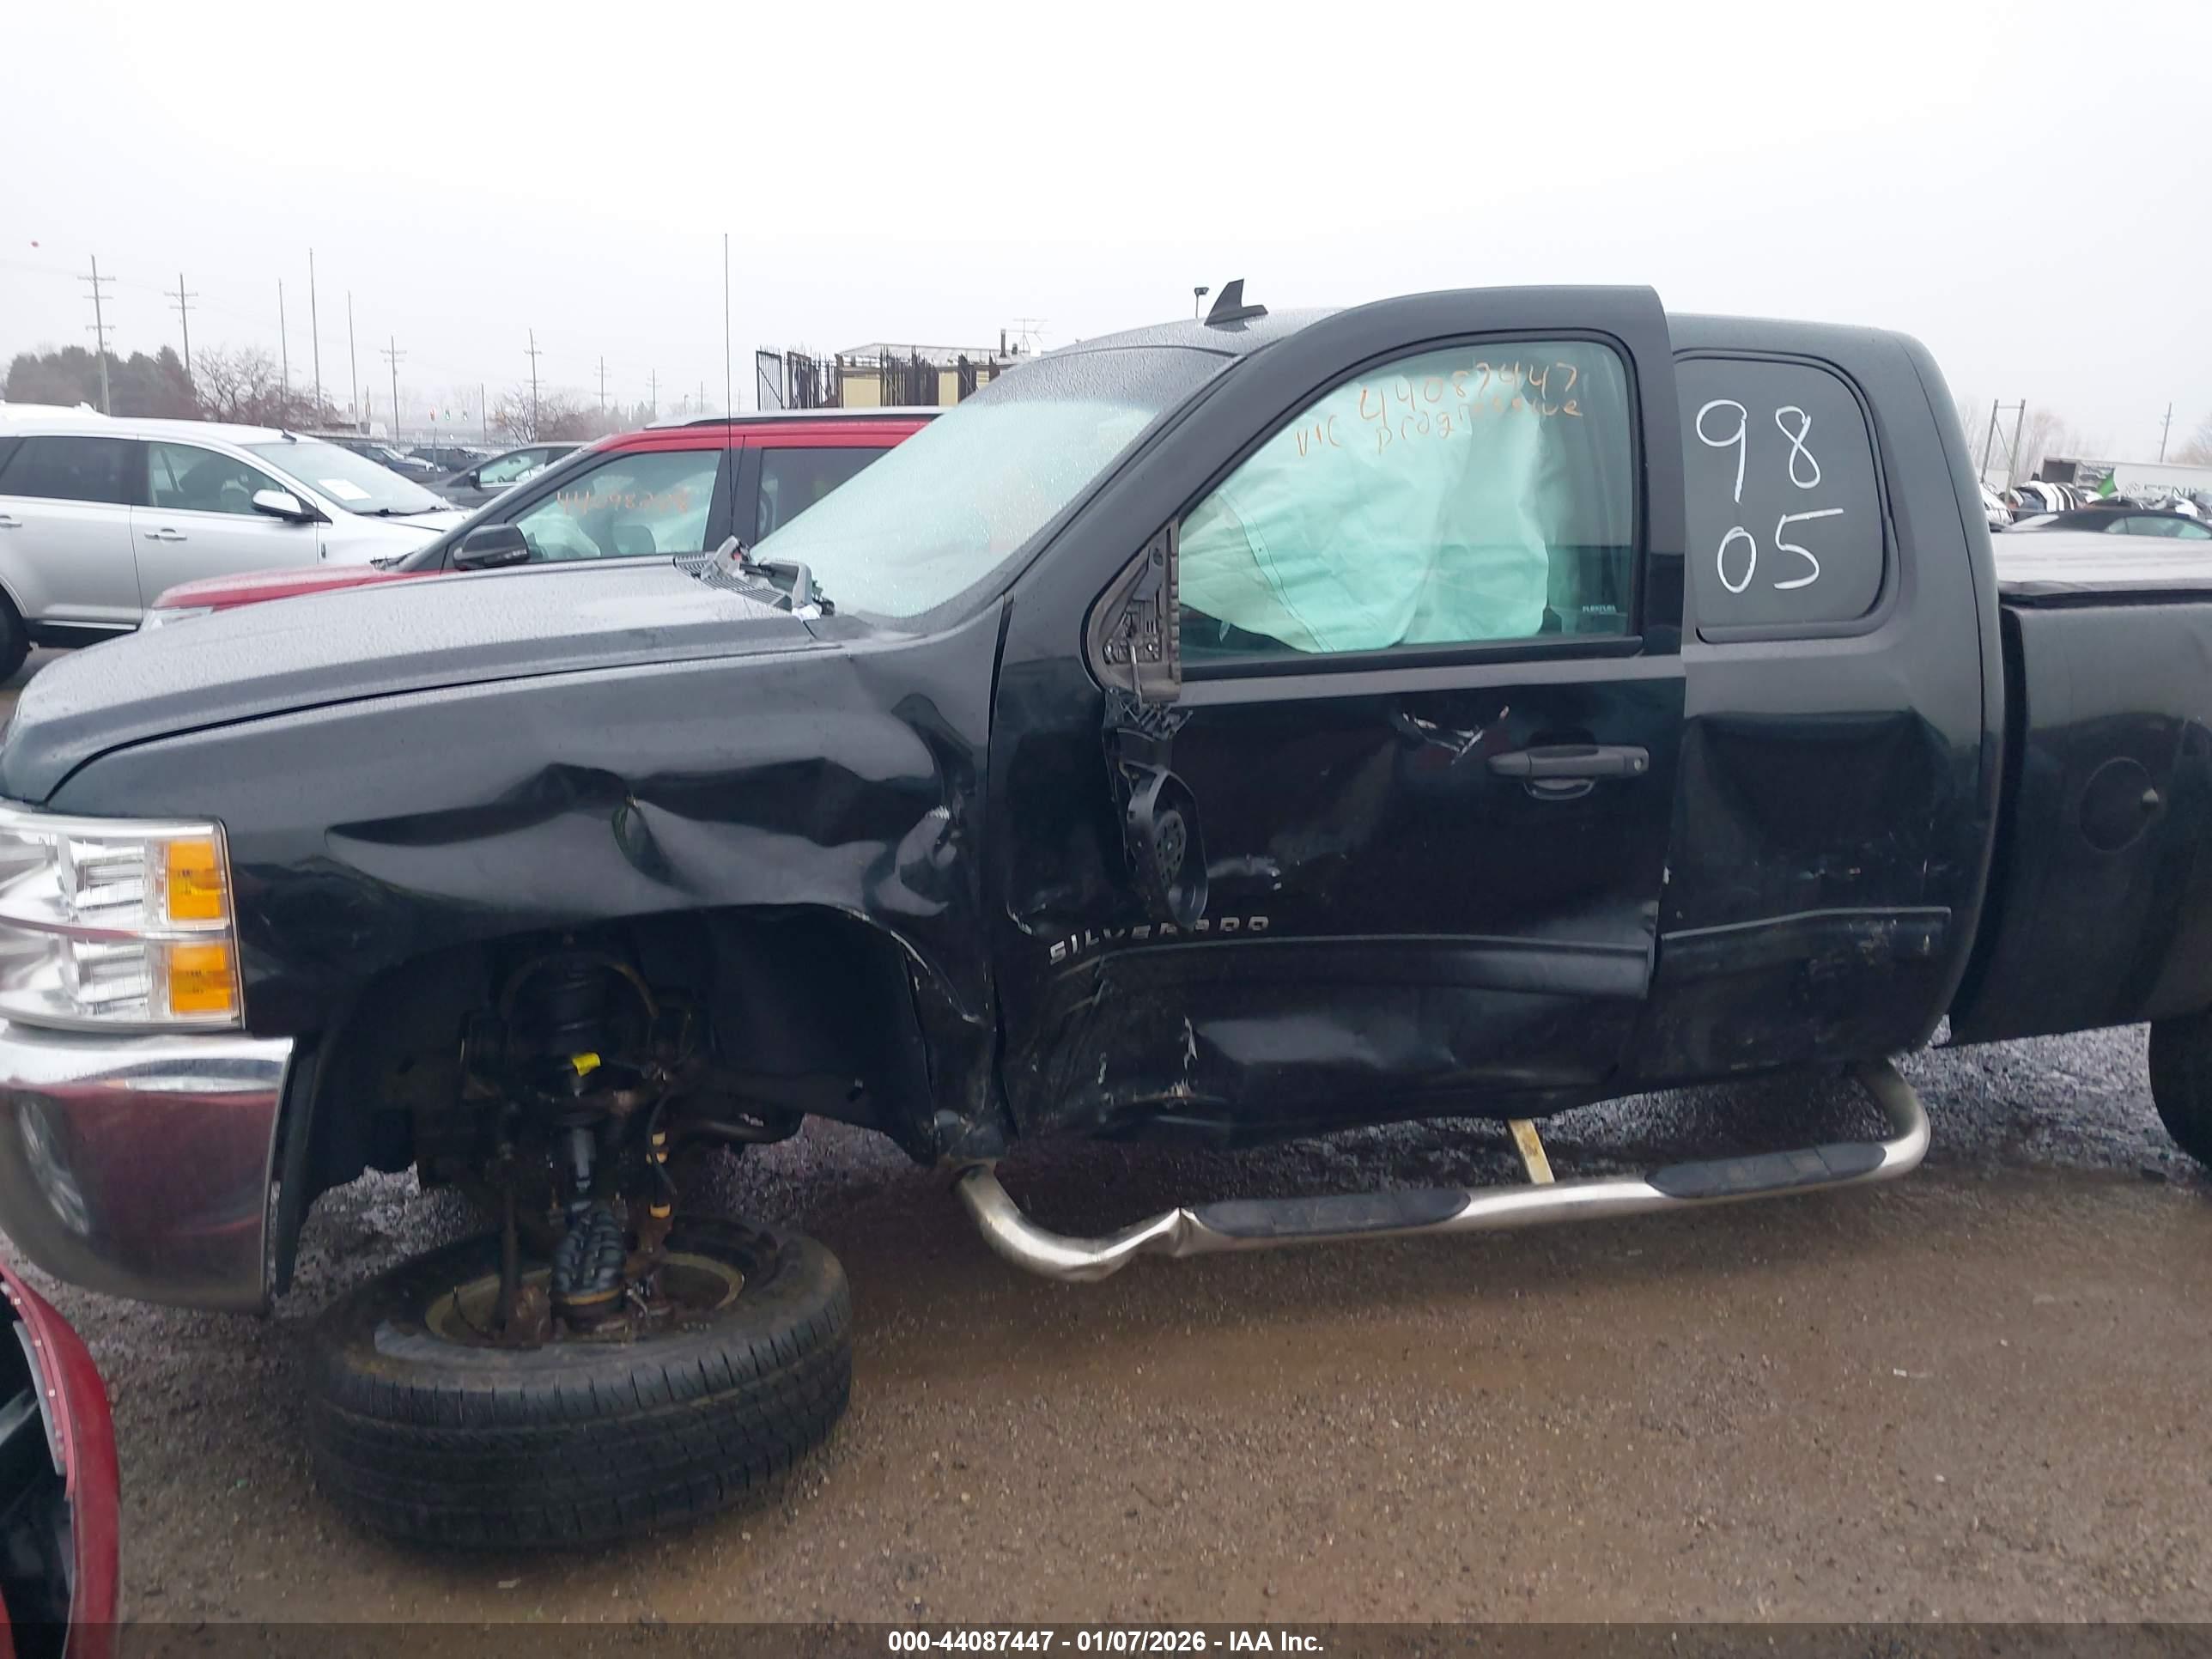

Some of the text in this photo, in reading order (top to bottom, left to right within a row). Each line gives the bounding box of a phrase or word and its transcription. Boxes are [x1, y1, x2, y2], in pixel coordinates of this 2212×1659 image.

[1359, 360, 1577, 428] 44087447
[1696, 399, 1821, 503] 98
[1717, 507, 1844, 593] 05
